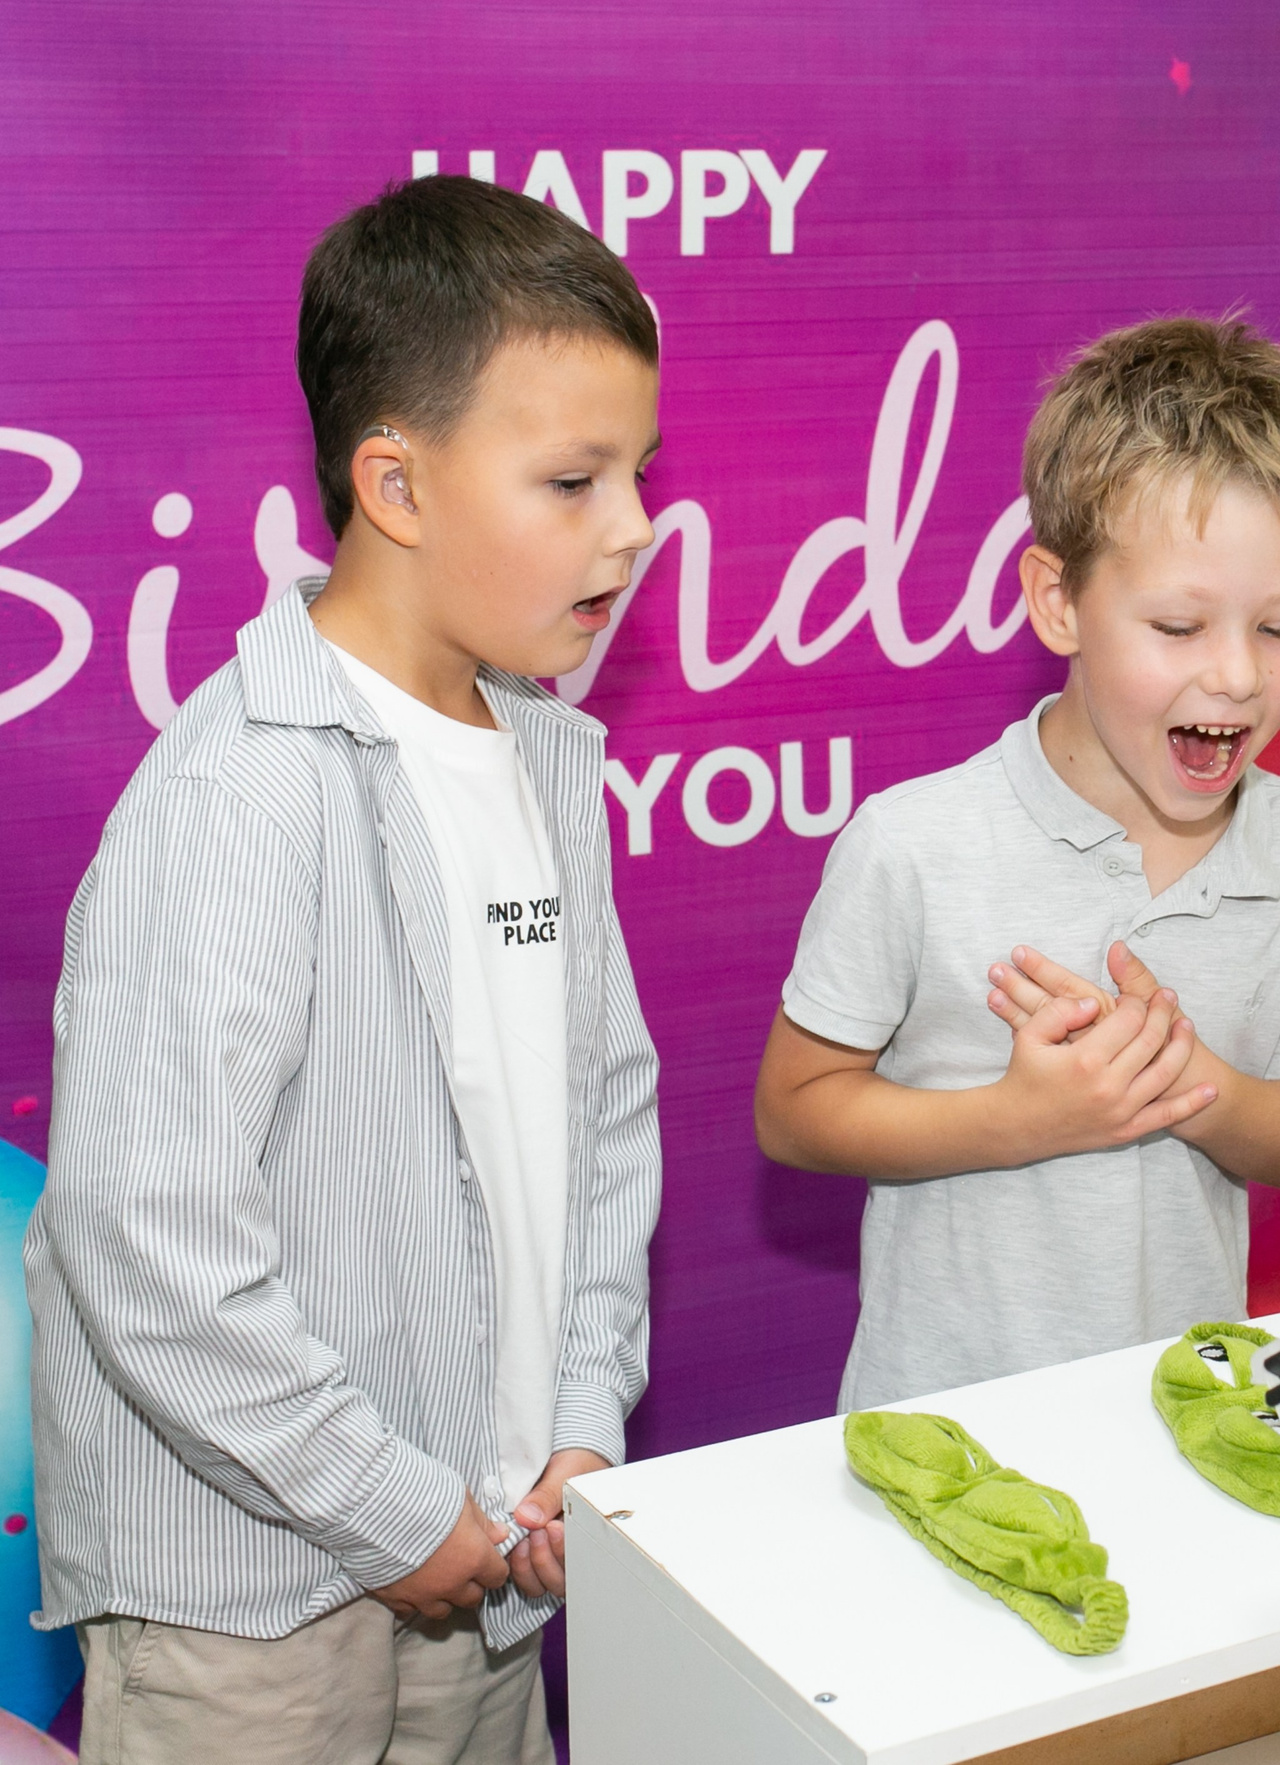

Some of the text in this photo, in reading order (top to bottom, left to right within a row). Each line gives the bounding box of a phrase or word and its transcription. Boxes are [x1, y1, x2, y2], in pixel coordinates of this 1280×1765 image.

[411, 148, 828, 256] APPY
[605, 736, 853, 856] YOU
[487, 901, 523, 924] FIND
[503, 921, 557, 946] PLACE
